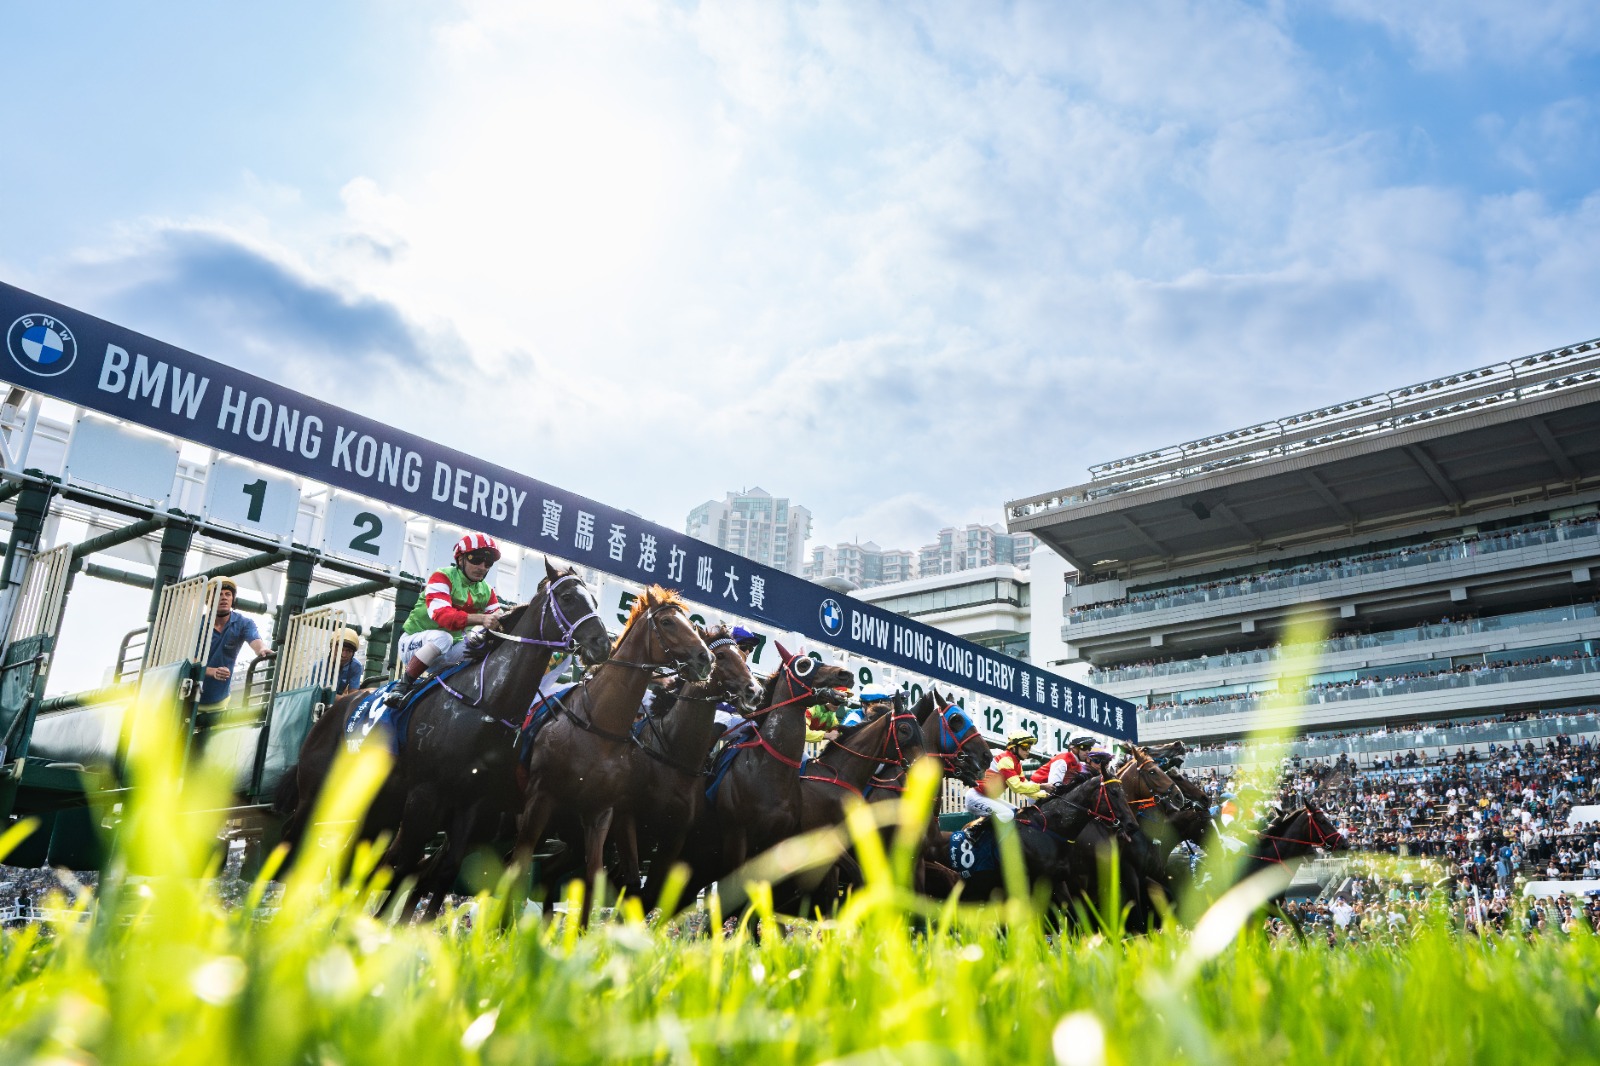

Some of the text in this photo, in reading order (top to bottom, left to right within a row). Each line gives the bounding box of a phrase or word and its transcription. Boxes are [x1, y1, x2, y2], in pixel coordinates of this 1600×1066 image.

[22, 317, 71, 341] BMW
[97, 343, 528, 527] BMW HONG KONG DERBY
[242, 478, 268, 522] 1
[348, 511, 383, 556] 2
[540, 498, 765, 611] 寶馬香港打吡大賽
[751, 631, 767, 665] 7
[851, 609, 1016, 693] BMW HONG KONG DERBY
[858, 666, 873, 692] 9
[1020, 670, 1124, 732] 寶馬香港打吡大賽
[983, 706, 1004, 735] 12
[960, 839, 975, 869] 8
